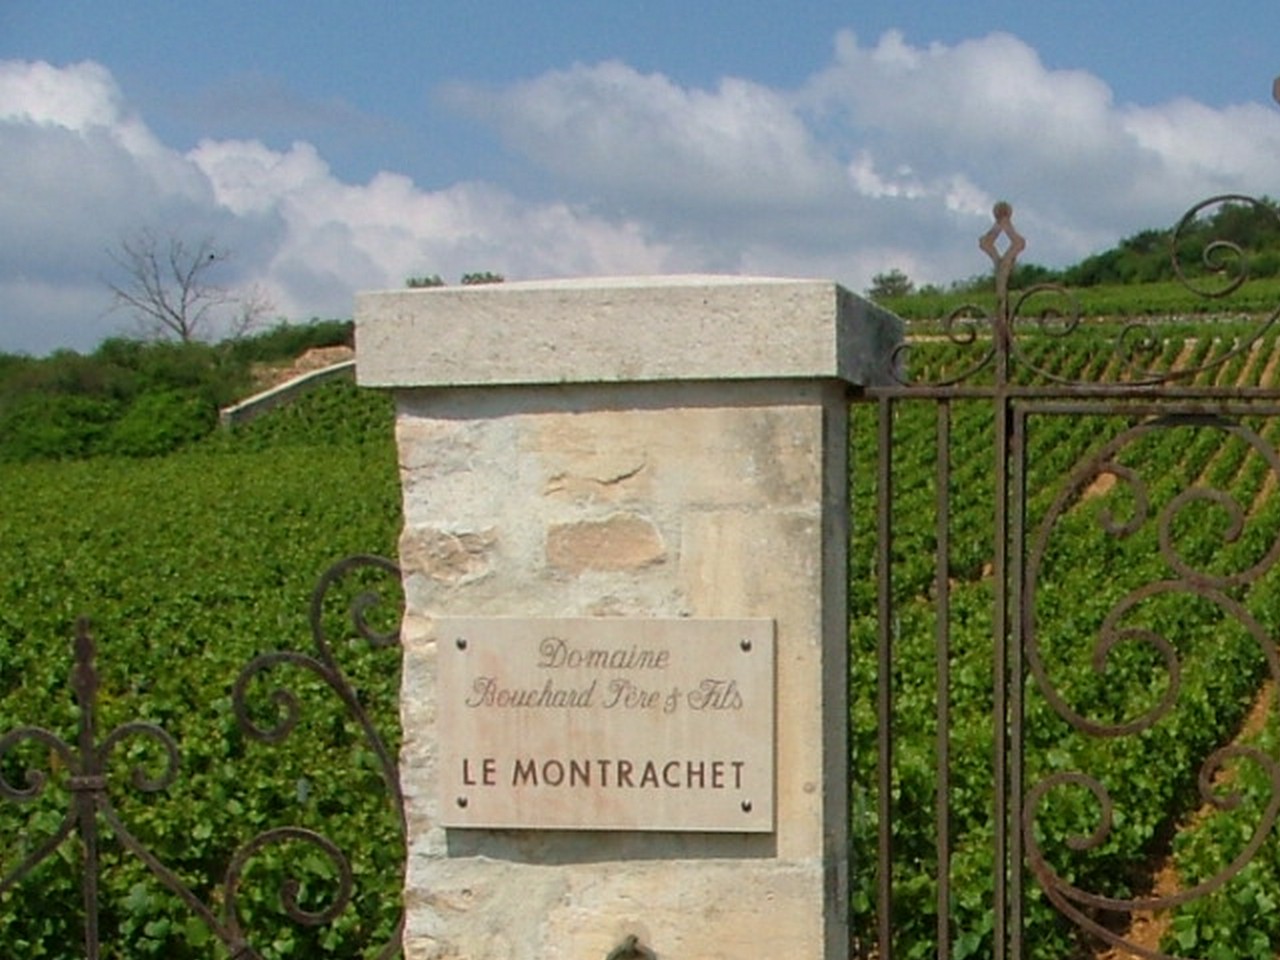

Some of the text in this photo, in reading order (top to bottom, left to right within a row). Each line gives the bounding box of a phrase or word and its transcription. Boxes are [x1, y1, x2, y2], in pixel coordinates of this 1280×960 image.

[537, 636, 671, 670] Domaine
[464, 676, 598, 709] Bouchard
[663, 686, 682, 715] &
[687, 678, 744, 711] Fils
[462, 758, 746, 790] LE MONTRACHET
